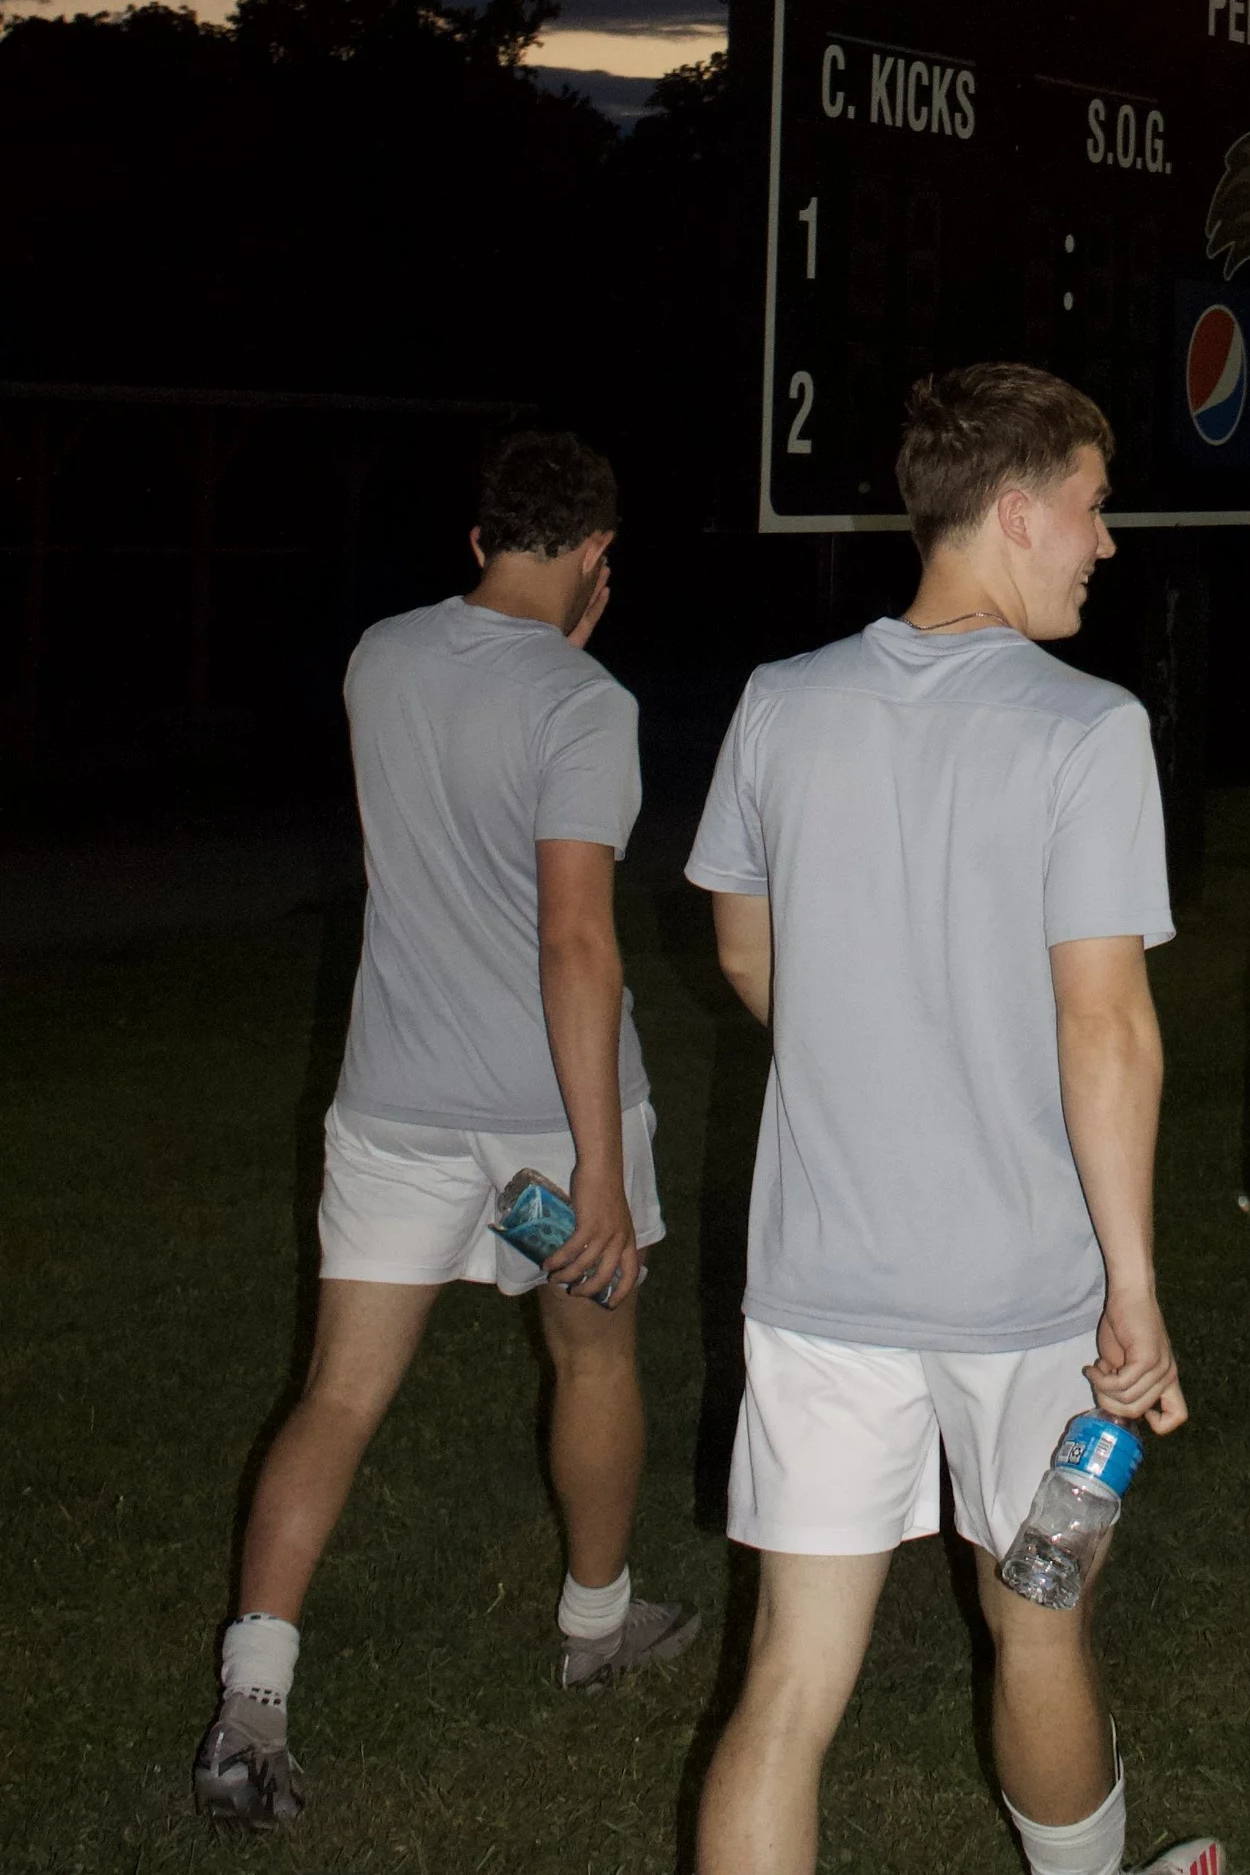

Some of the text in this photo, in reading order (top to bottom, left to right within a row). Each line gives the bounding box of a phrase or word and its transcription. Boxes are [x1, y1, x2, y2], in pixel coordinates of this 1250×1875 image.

[822, 44, 976, 140] C. KICKS
[1086, 99, 1172, 174] S.O.G.
[799, 197, 819, 280] 1
[787, 370, 814, 455] 2
